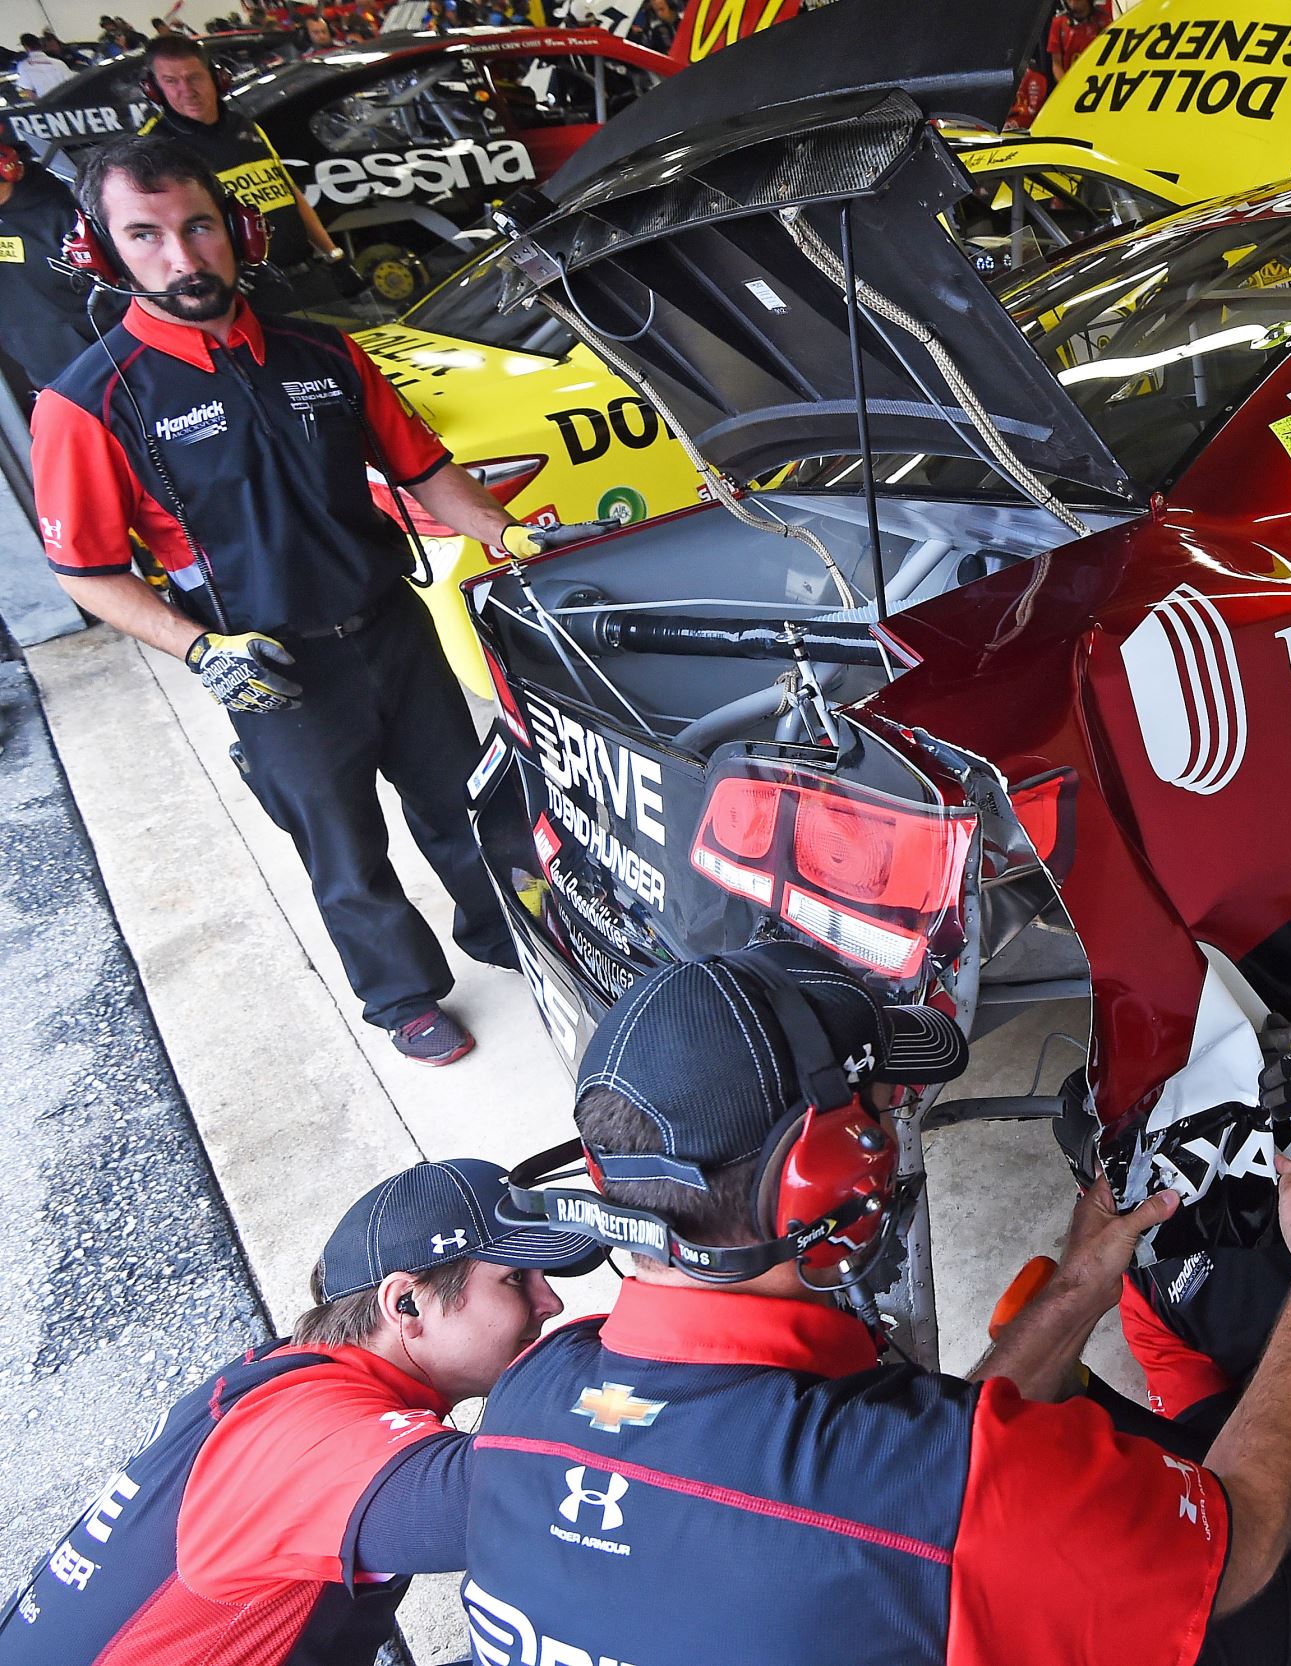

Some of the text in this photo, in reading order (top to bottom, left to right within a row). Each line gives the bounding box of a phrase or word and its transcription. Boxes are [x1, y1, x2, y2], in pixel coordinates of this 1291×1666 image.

[1073, 69, 1288, 120] DOLLAR
[9, 106, 124, 142] DENVER
[281, 378, 338, 396] DRIVE
[156, 400, 225, 441] Hendrick
[523, 690, 666, 847] DRIVE
[545, 777, 666, 913] TO END HUNGER
[566, 874, 631, 956] Possibilities
[678, 1243, 710, 1266] TOM S
[797, 1225, 826, 1249] Sprint
[550, 1524, 632, 1556] UNDER ARMOUR
